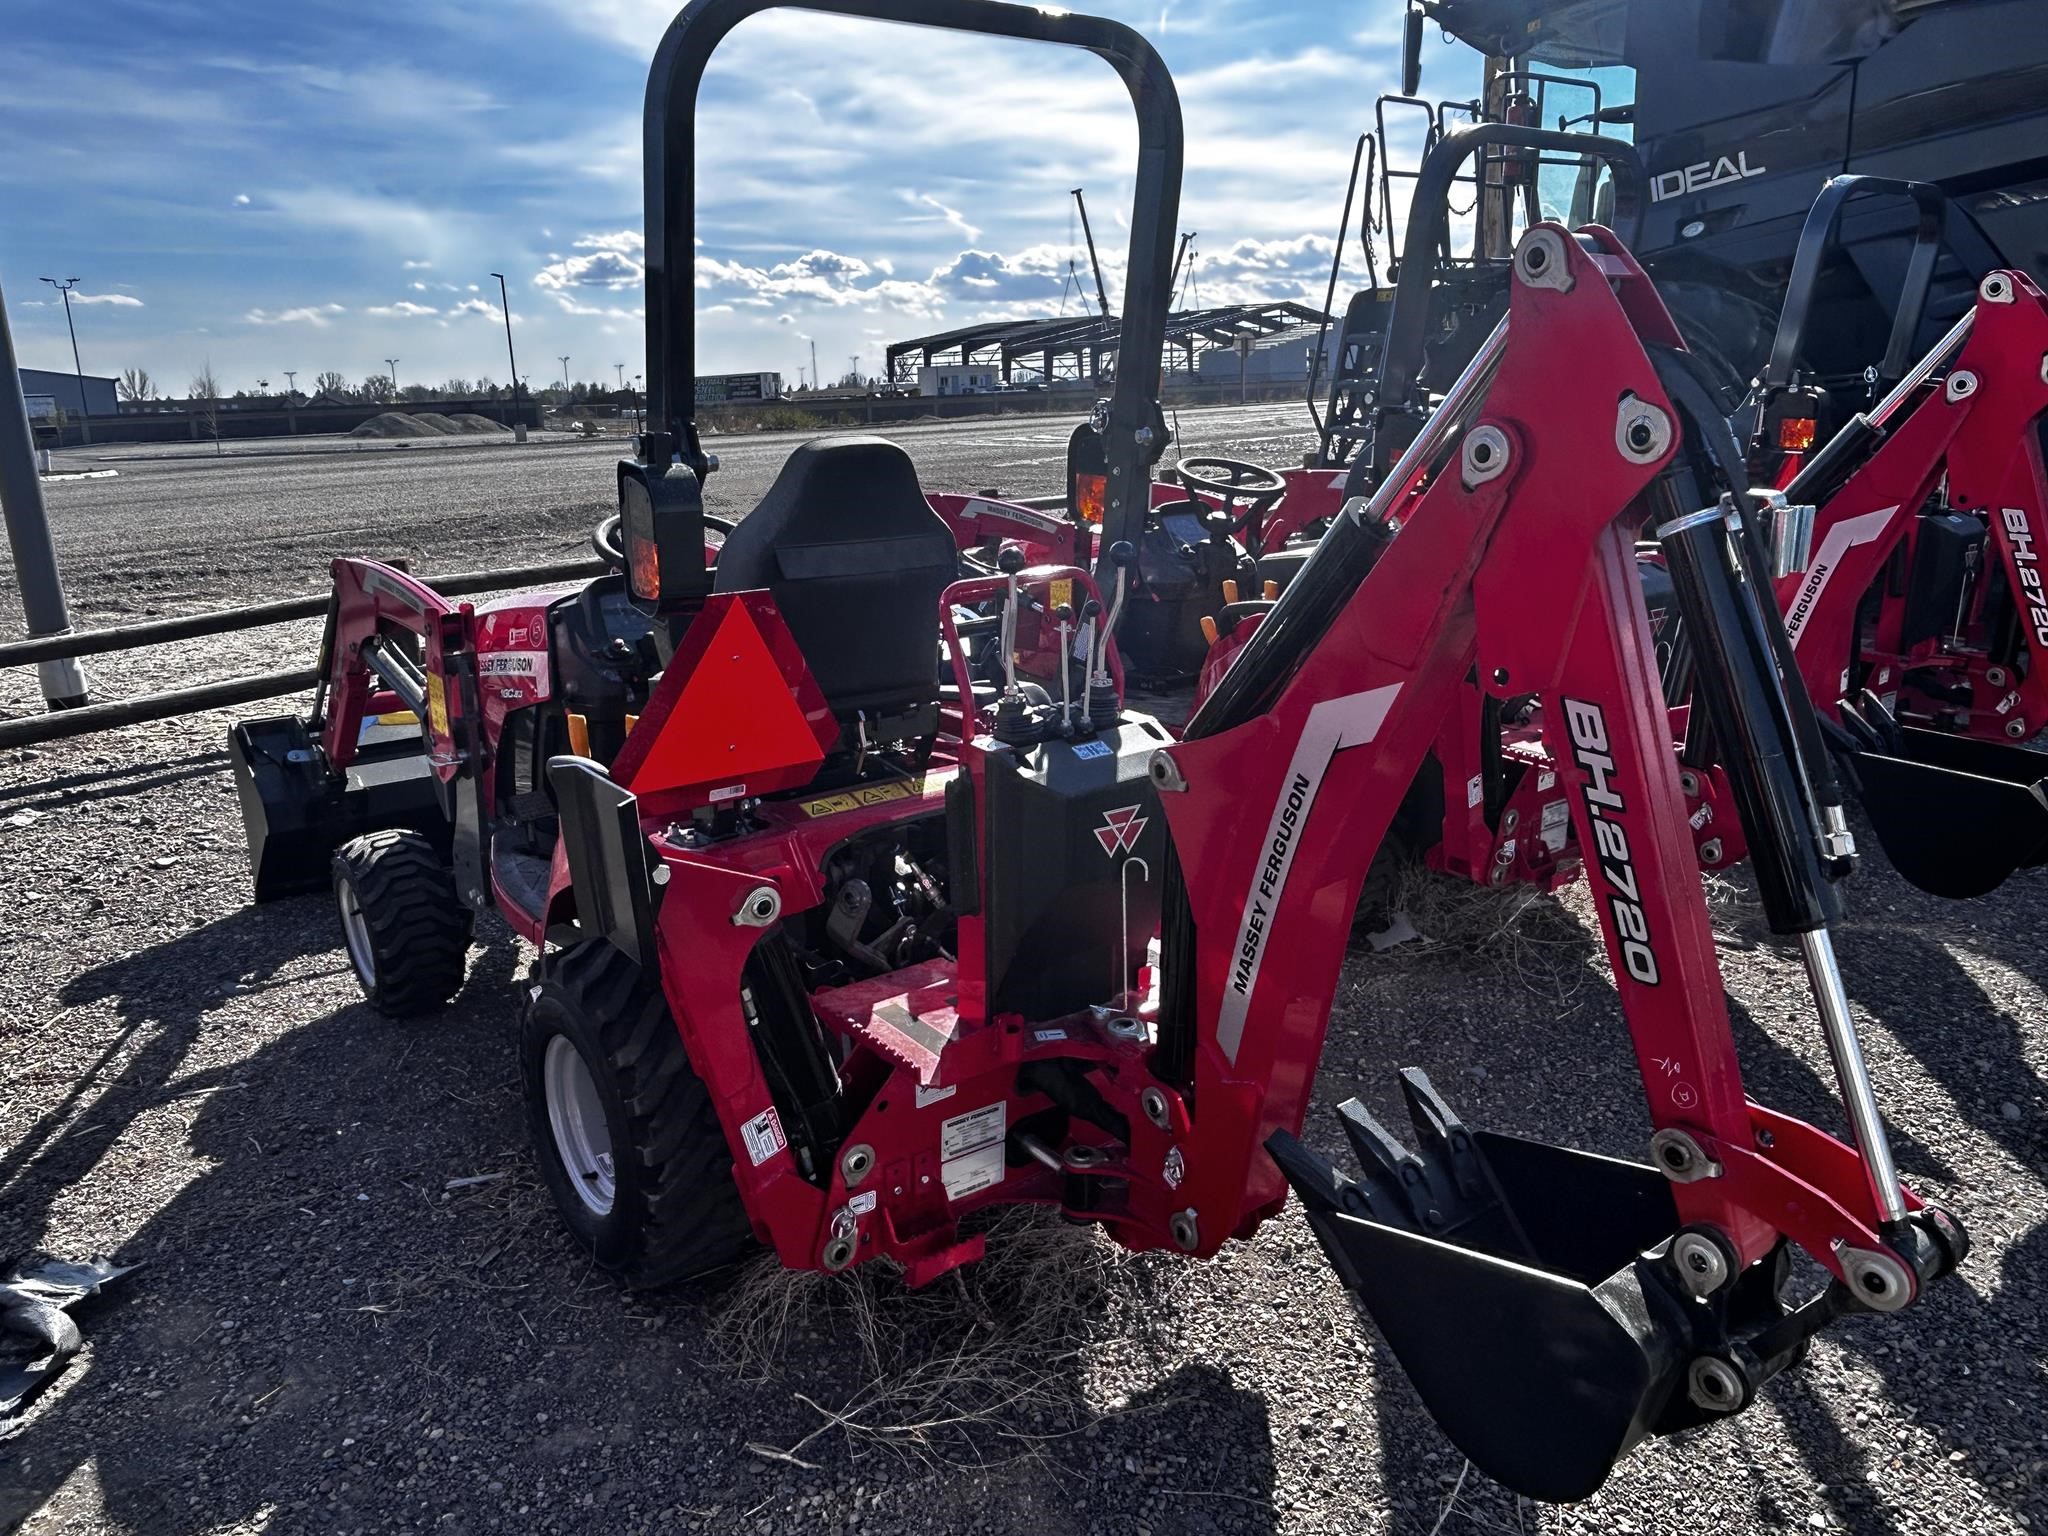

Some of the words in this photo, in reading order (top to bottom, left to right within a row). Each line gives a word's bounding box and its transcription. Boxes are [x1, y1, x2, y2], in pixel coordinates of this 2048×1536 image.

[1649, 150, 1767, 203] IDEAL
[1786, 563, 1829, 640] FERGUSON
[1233, 900, 1267, 996] MASSEY
[1259, 772, 1311, 900] FERGUSON
[1562, 697, 1660, 985] BH.2720
